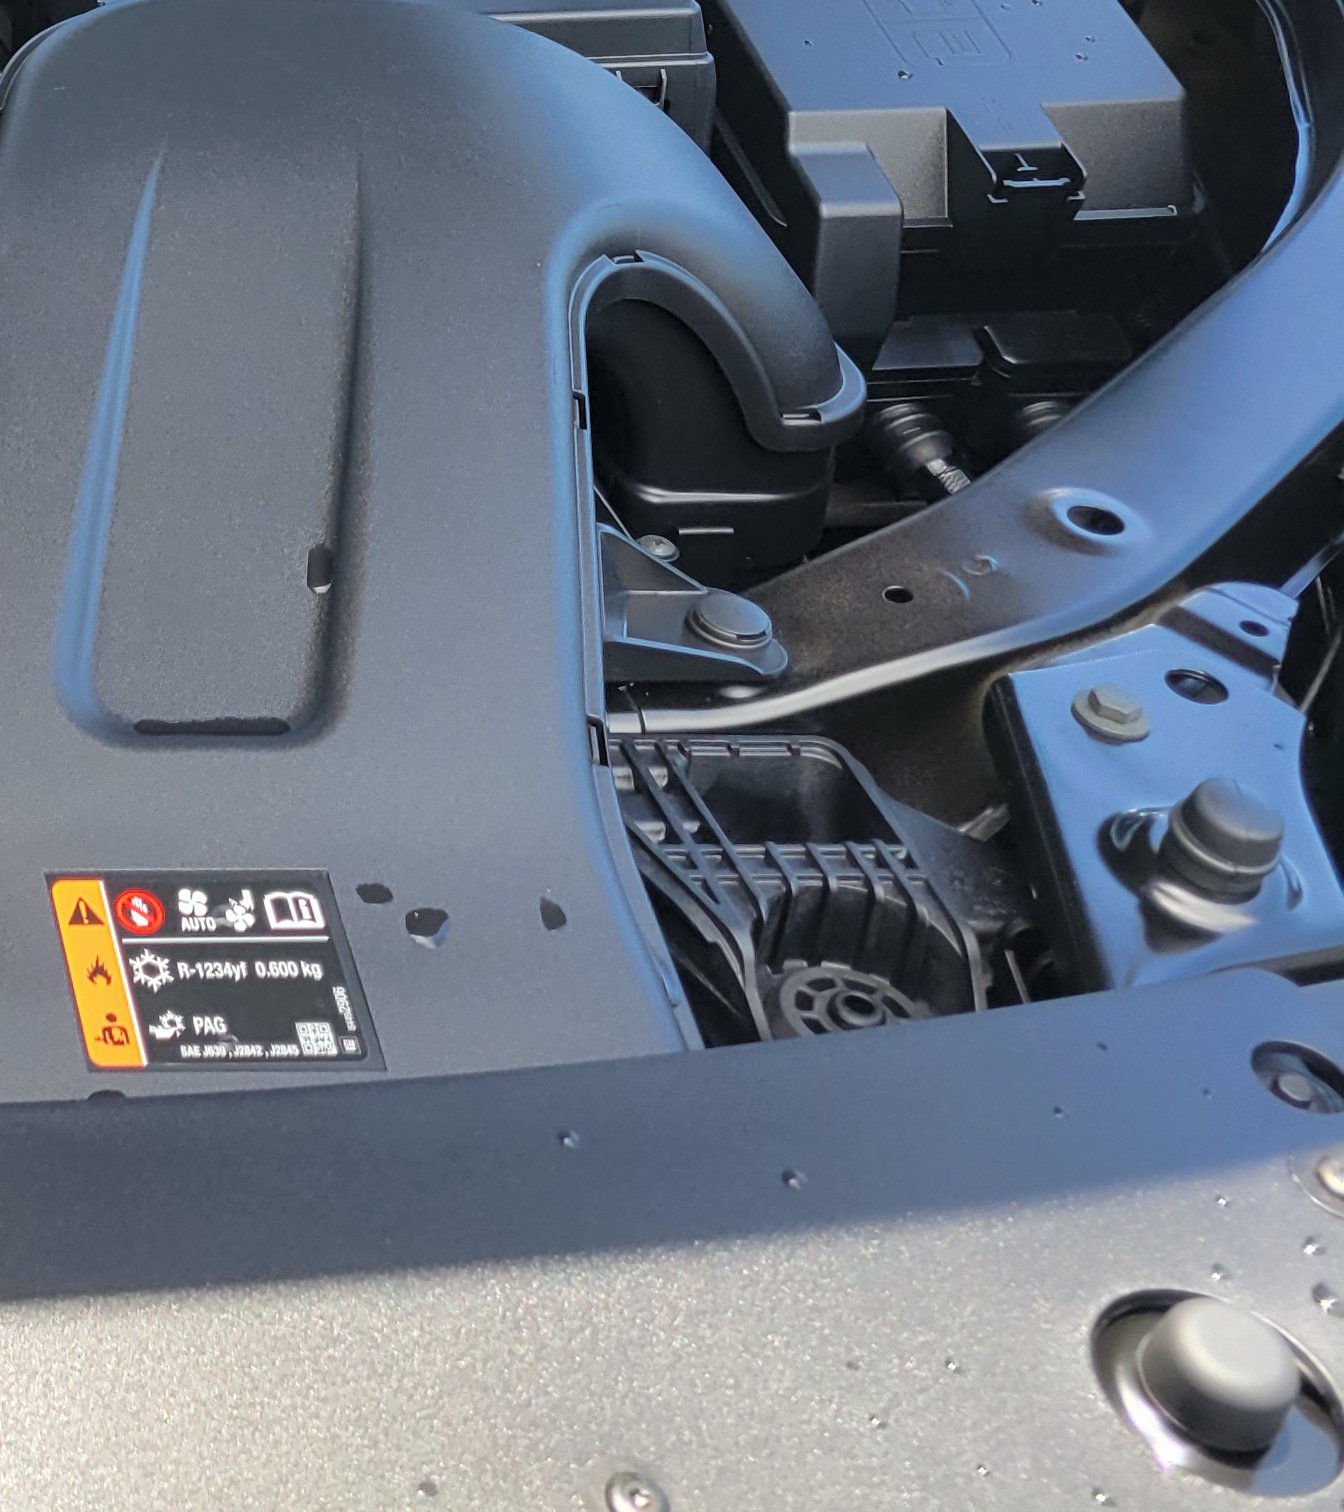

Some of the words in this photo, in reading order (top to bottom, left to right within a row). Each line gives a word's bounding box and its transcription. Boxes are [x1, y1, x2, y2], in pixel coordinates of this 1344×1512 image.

[181, 916, 216, 932] AUTO
[176, 960, 249, 983] R-1234yf
[299, 959, 324, 982] kg
[192, 1015, 227, 1036] PAG
